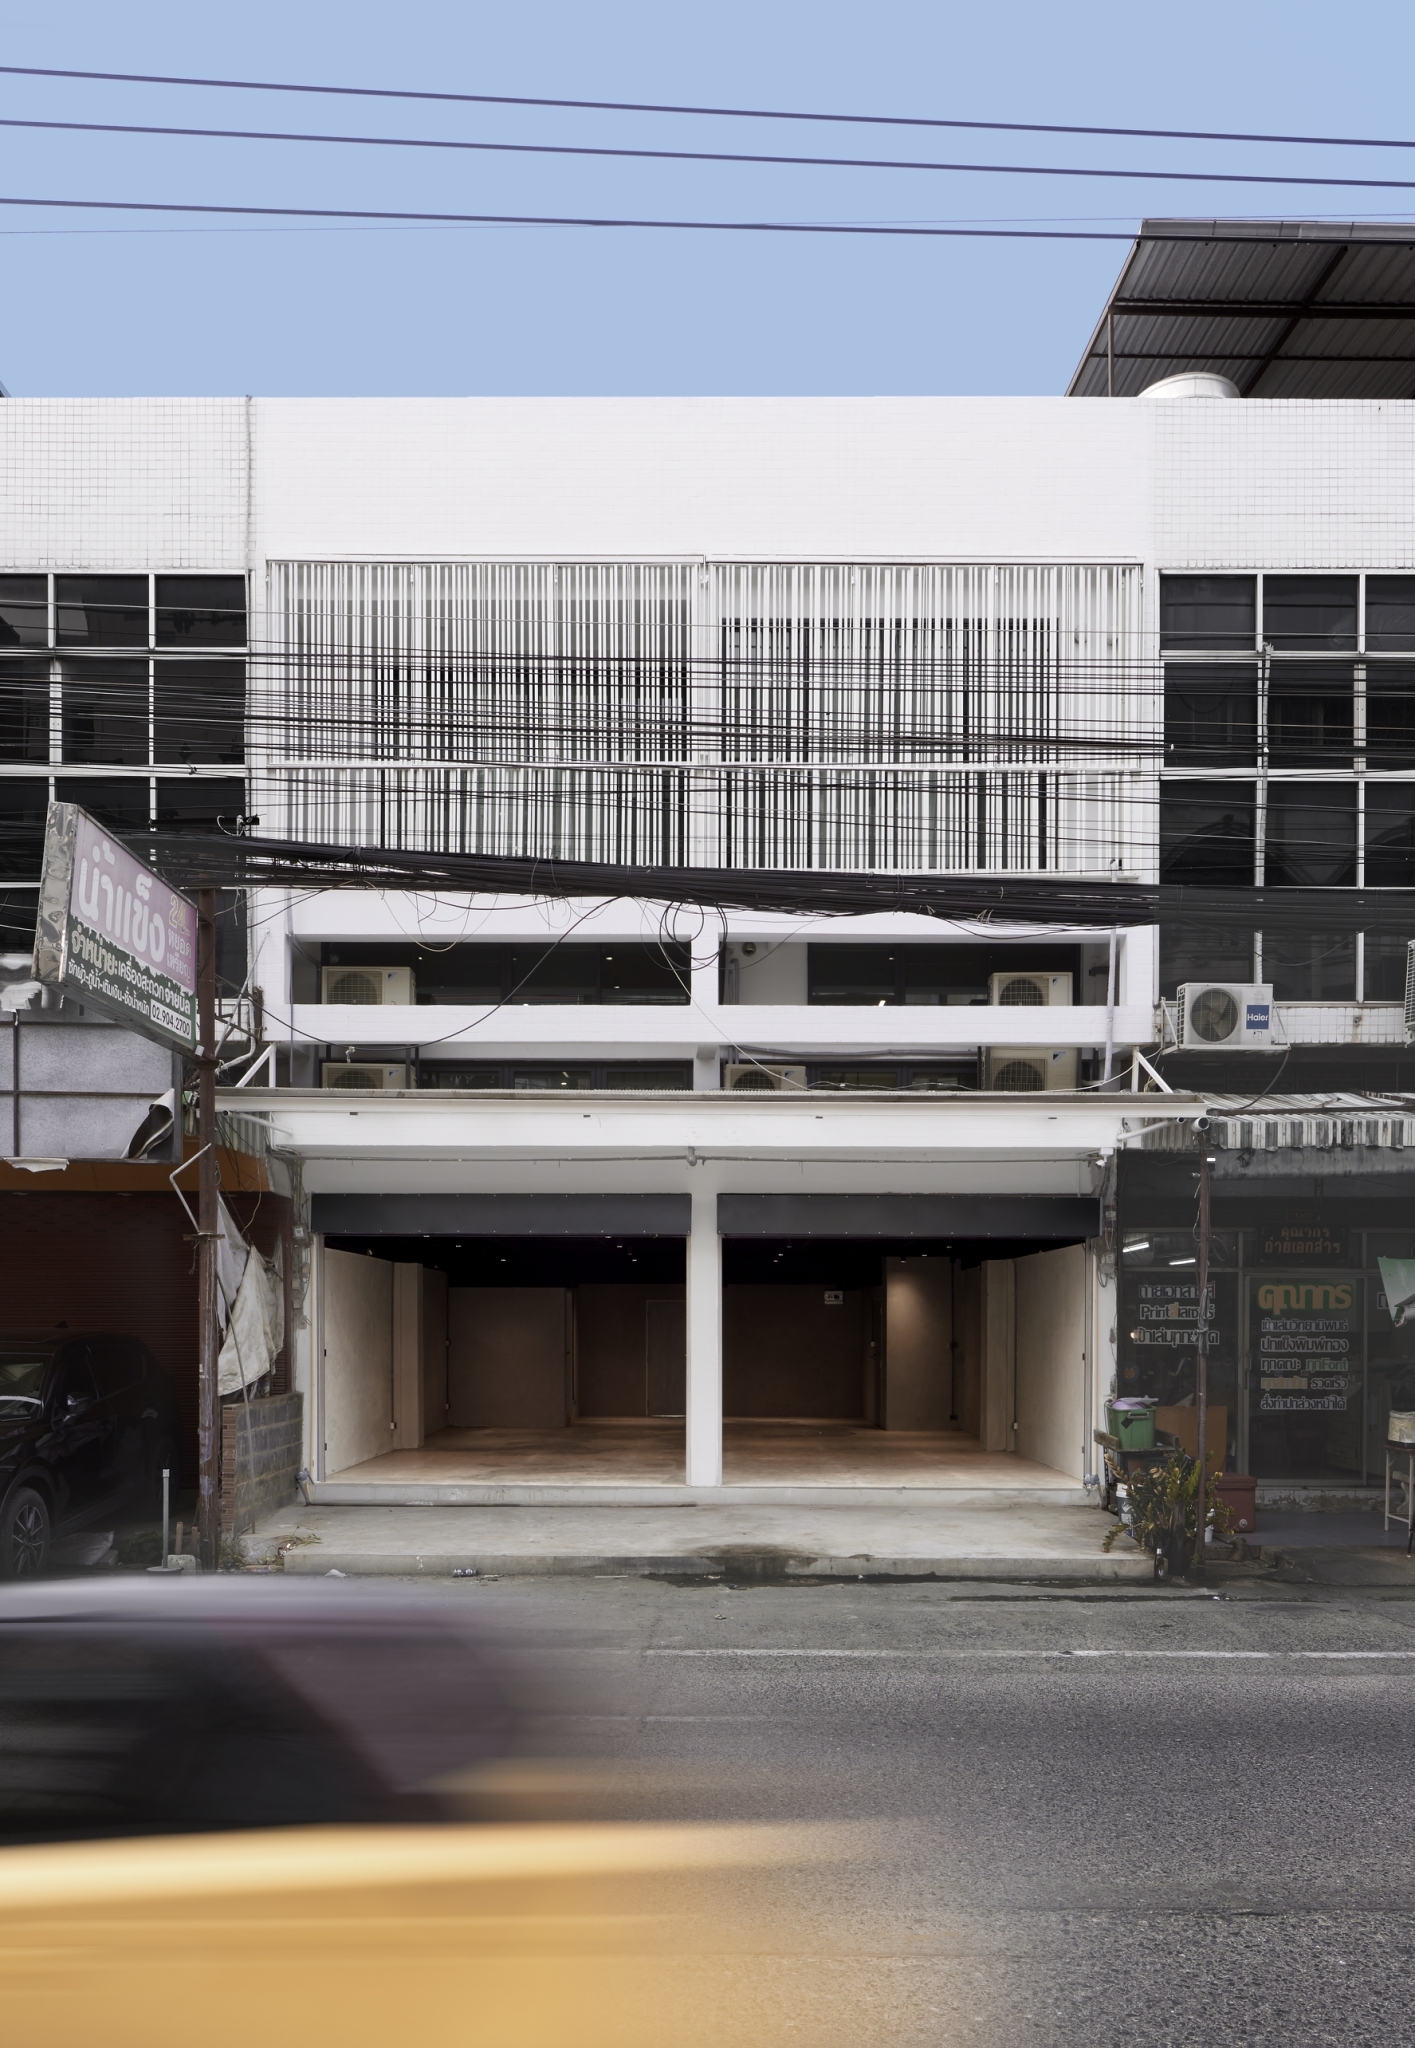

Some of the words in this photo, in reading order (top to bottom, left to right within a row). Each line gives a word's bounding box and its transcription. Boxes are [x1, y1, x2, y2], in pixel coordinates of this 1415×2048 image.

[78, 839, 166, 963] น้ำแข็ง
[168, 894, 186, 935] 24
[166, 950, 191, 985] เหรียญ
[152, 1002, 191, 1036] 02.904.2700
[1247, 1013, 1269, 1021] Haier
[1281, 1226, 1330, 1241] คุณากร
[1264, 1237, 1341, 1254] ถ่ายเอกสาร
[1258, 1284, 1352, 1315] คุณากร
[1261, 1318, 1348, 1331] เข้าเล่มวิทยานิพนธ์
[1261, 1336, 1348, 1351] ปกแข็งพิมพ์ทอง
[1261, 1359, 1301, 1372] ทุกคณะ
[1311, 1376, 1347, 1389] รวดเร็ว
